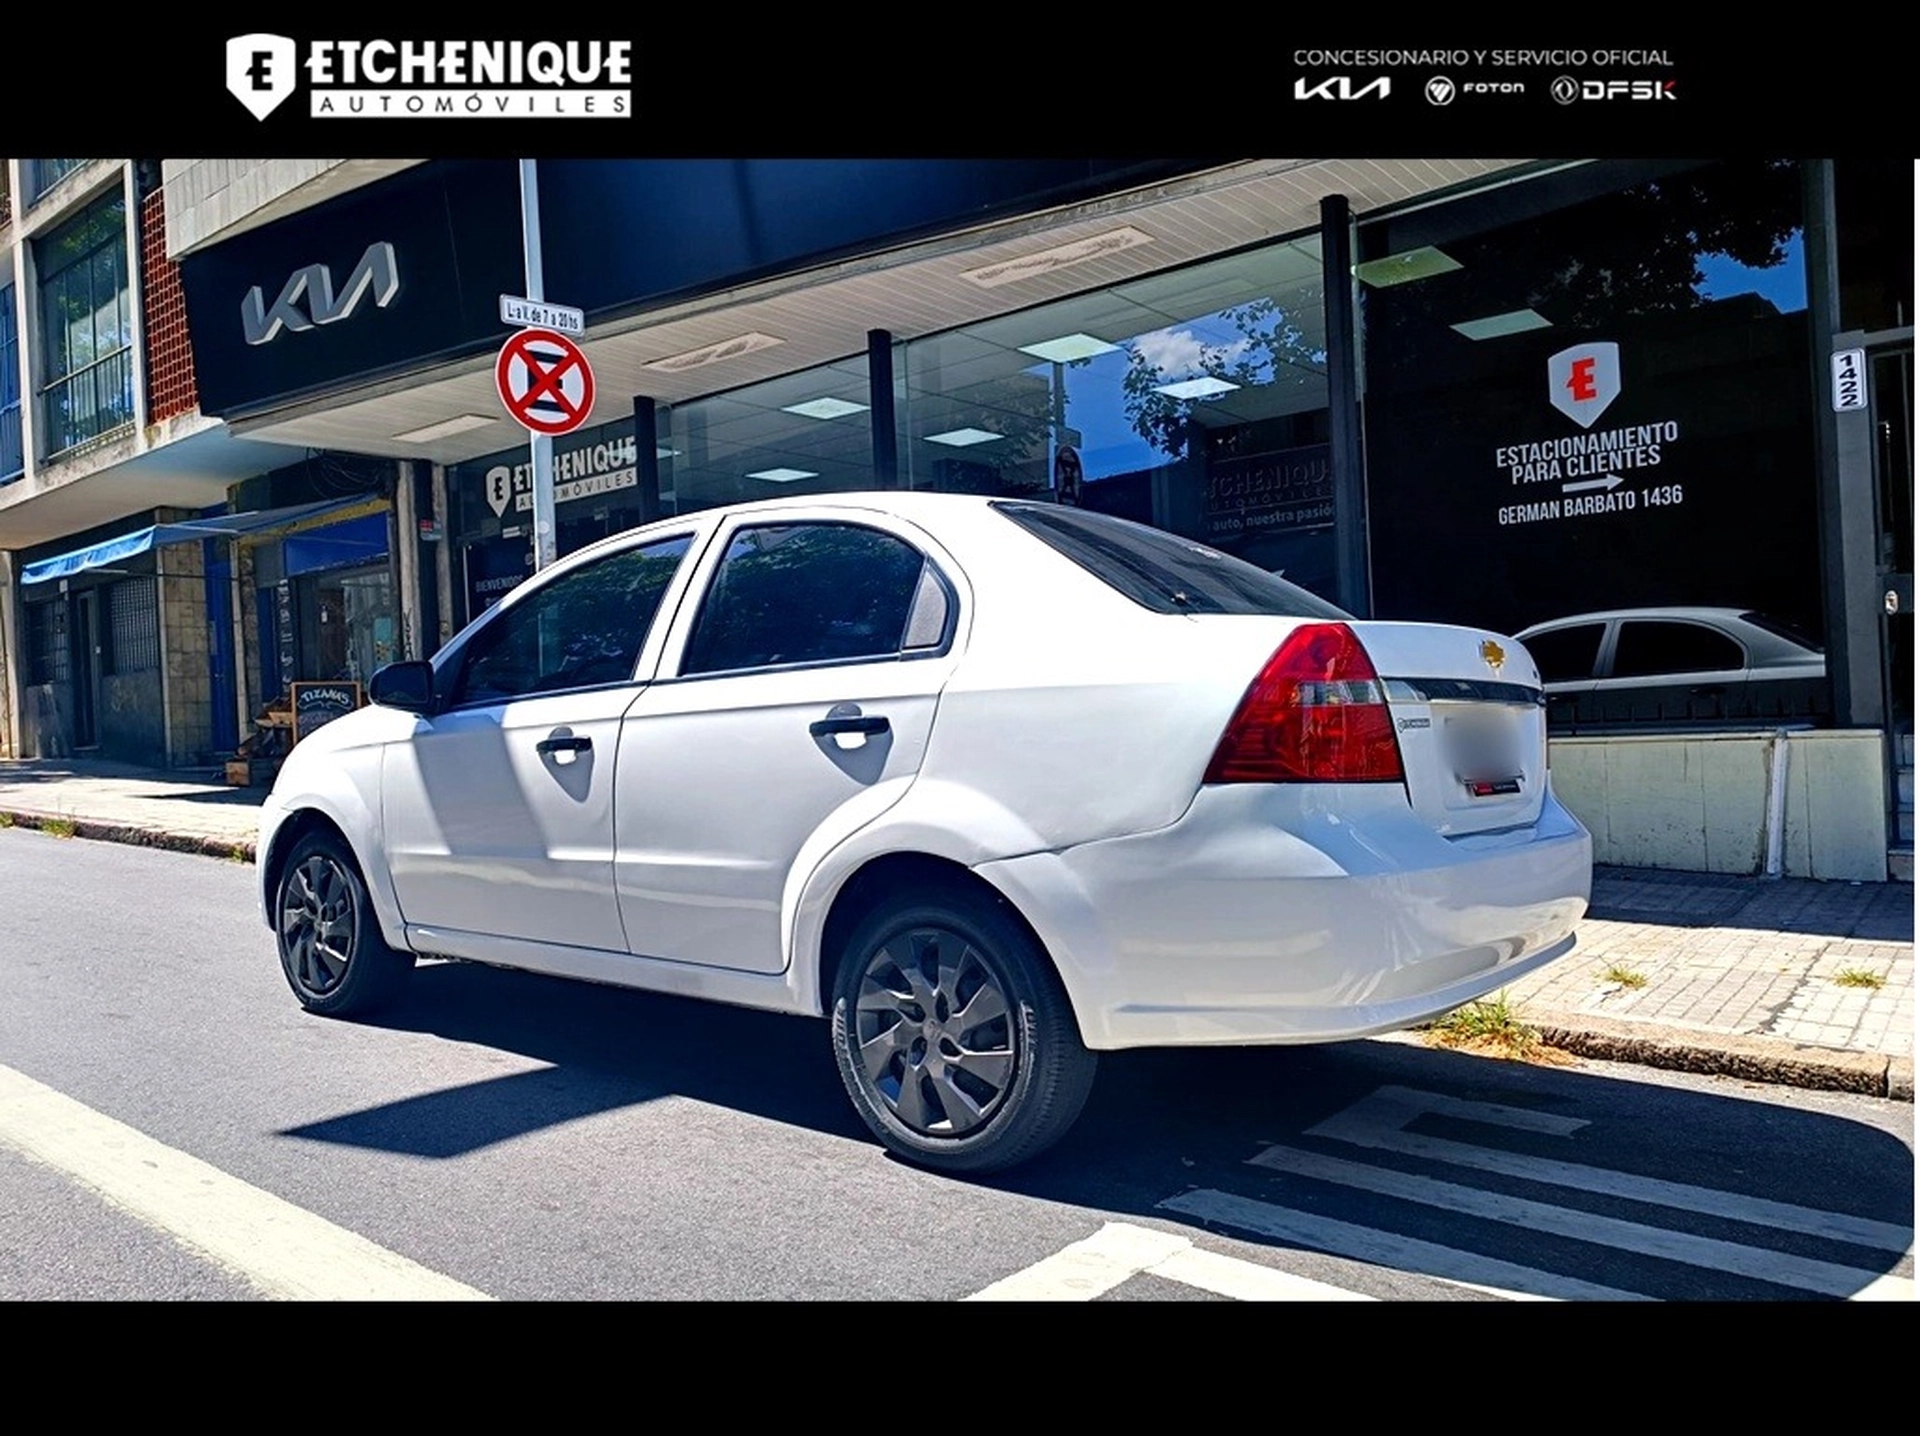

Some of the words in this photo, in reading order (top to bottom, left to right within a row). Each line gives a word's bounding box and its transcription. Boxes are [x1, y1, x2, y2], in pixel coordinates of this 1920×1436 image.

[241, 241, 399, 345] KIA
[532, 306, 541, 323] de
[543, 309, 549, 324] 7
[551, 313, 557, 326] a
[1839, 354, 1858, 407] 1422
[513, 435, 638, 491] ETHENIQUE
[1496, 420, 1679, 468] ESTACIONAMIENTO
[1511, 460, 1562, 485] PARA
[1566, 444, 1662, 478] CLIENTES
[518, 470, 633, 507] AMÓVILES
[1498, 500, 1560, 525] GERMAN
[1564, 490, 1636, 517] BARBATO
[1641, 484, 1684, 507] 1436
[1246, 509, 1295, 527] nuestra
